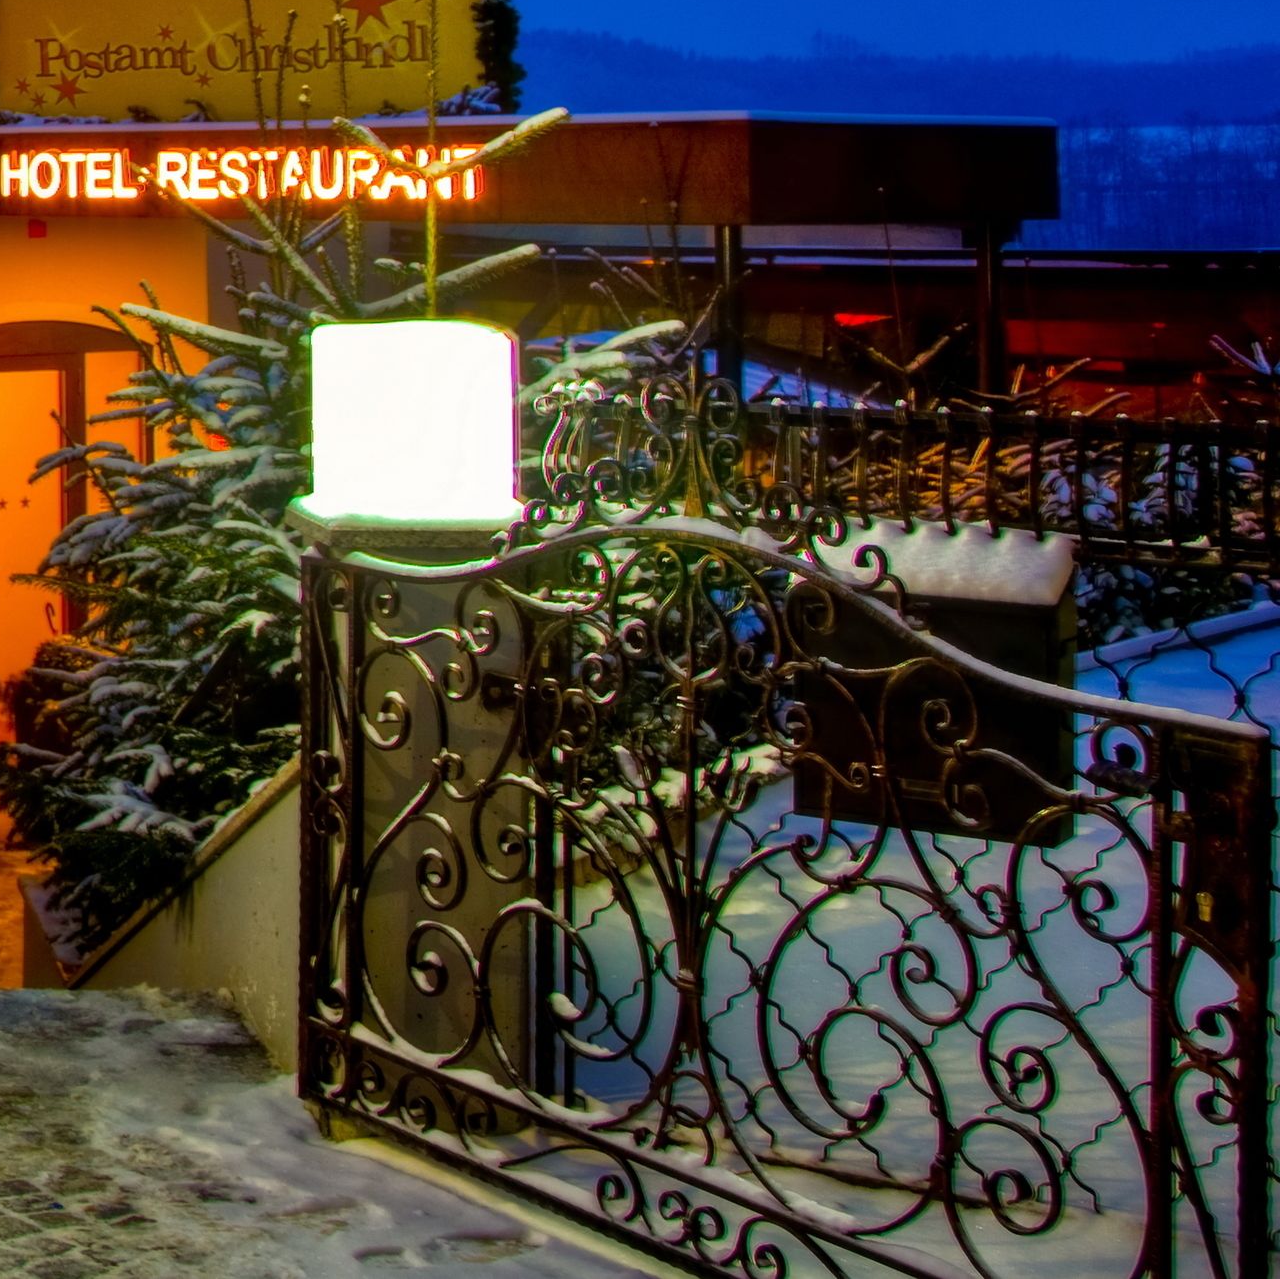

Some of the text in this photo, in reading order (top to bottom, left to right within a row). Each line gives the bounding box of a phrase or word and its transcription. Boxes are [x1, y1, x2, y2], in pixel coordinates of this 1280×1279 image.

[33, 35, 196, 79] Postamt
[0, 148, 480, 200] HOTEL RESTAURANT
